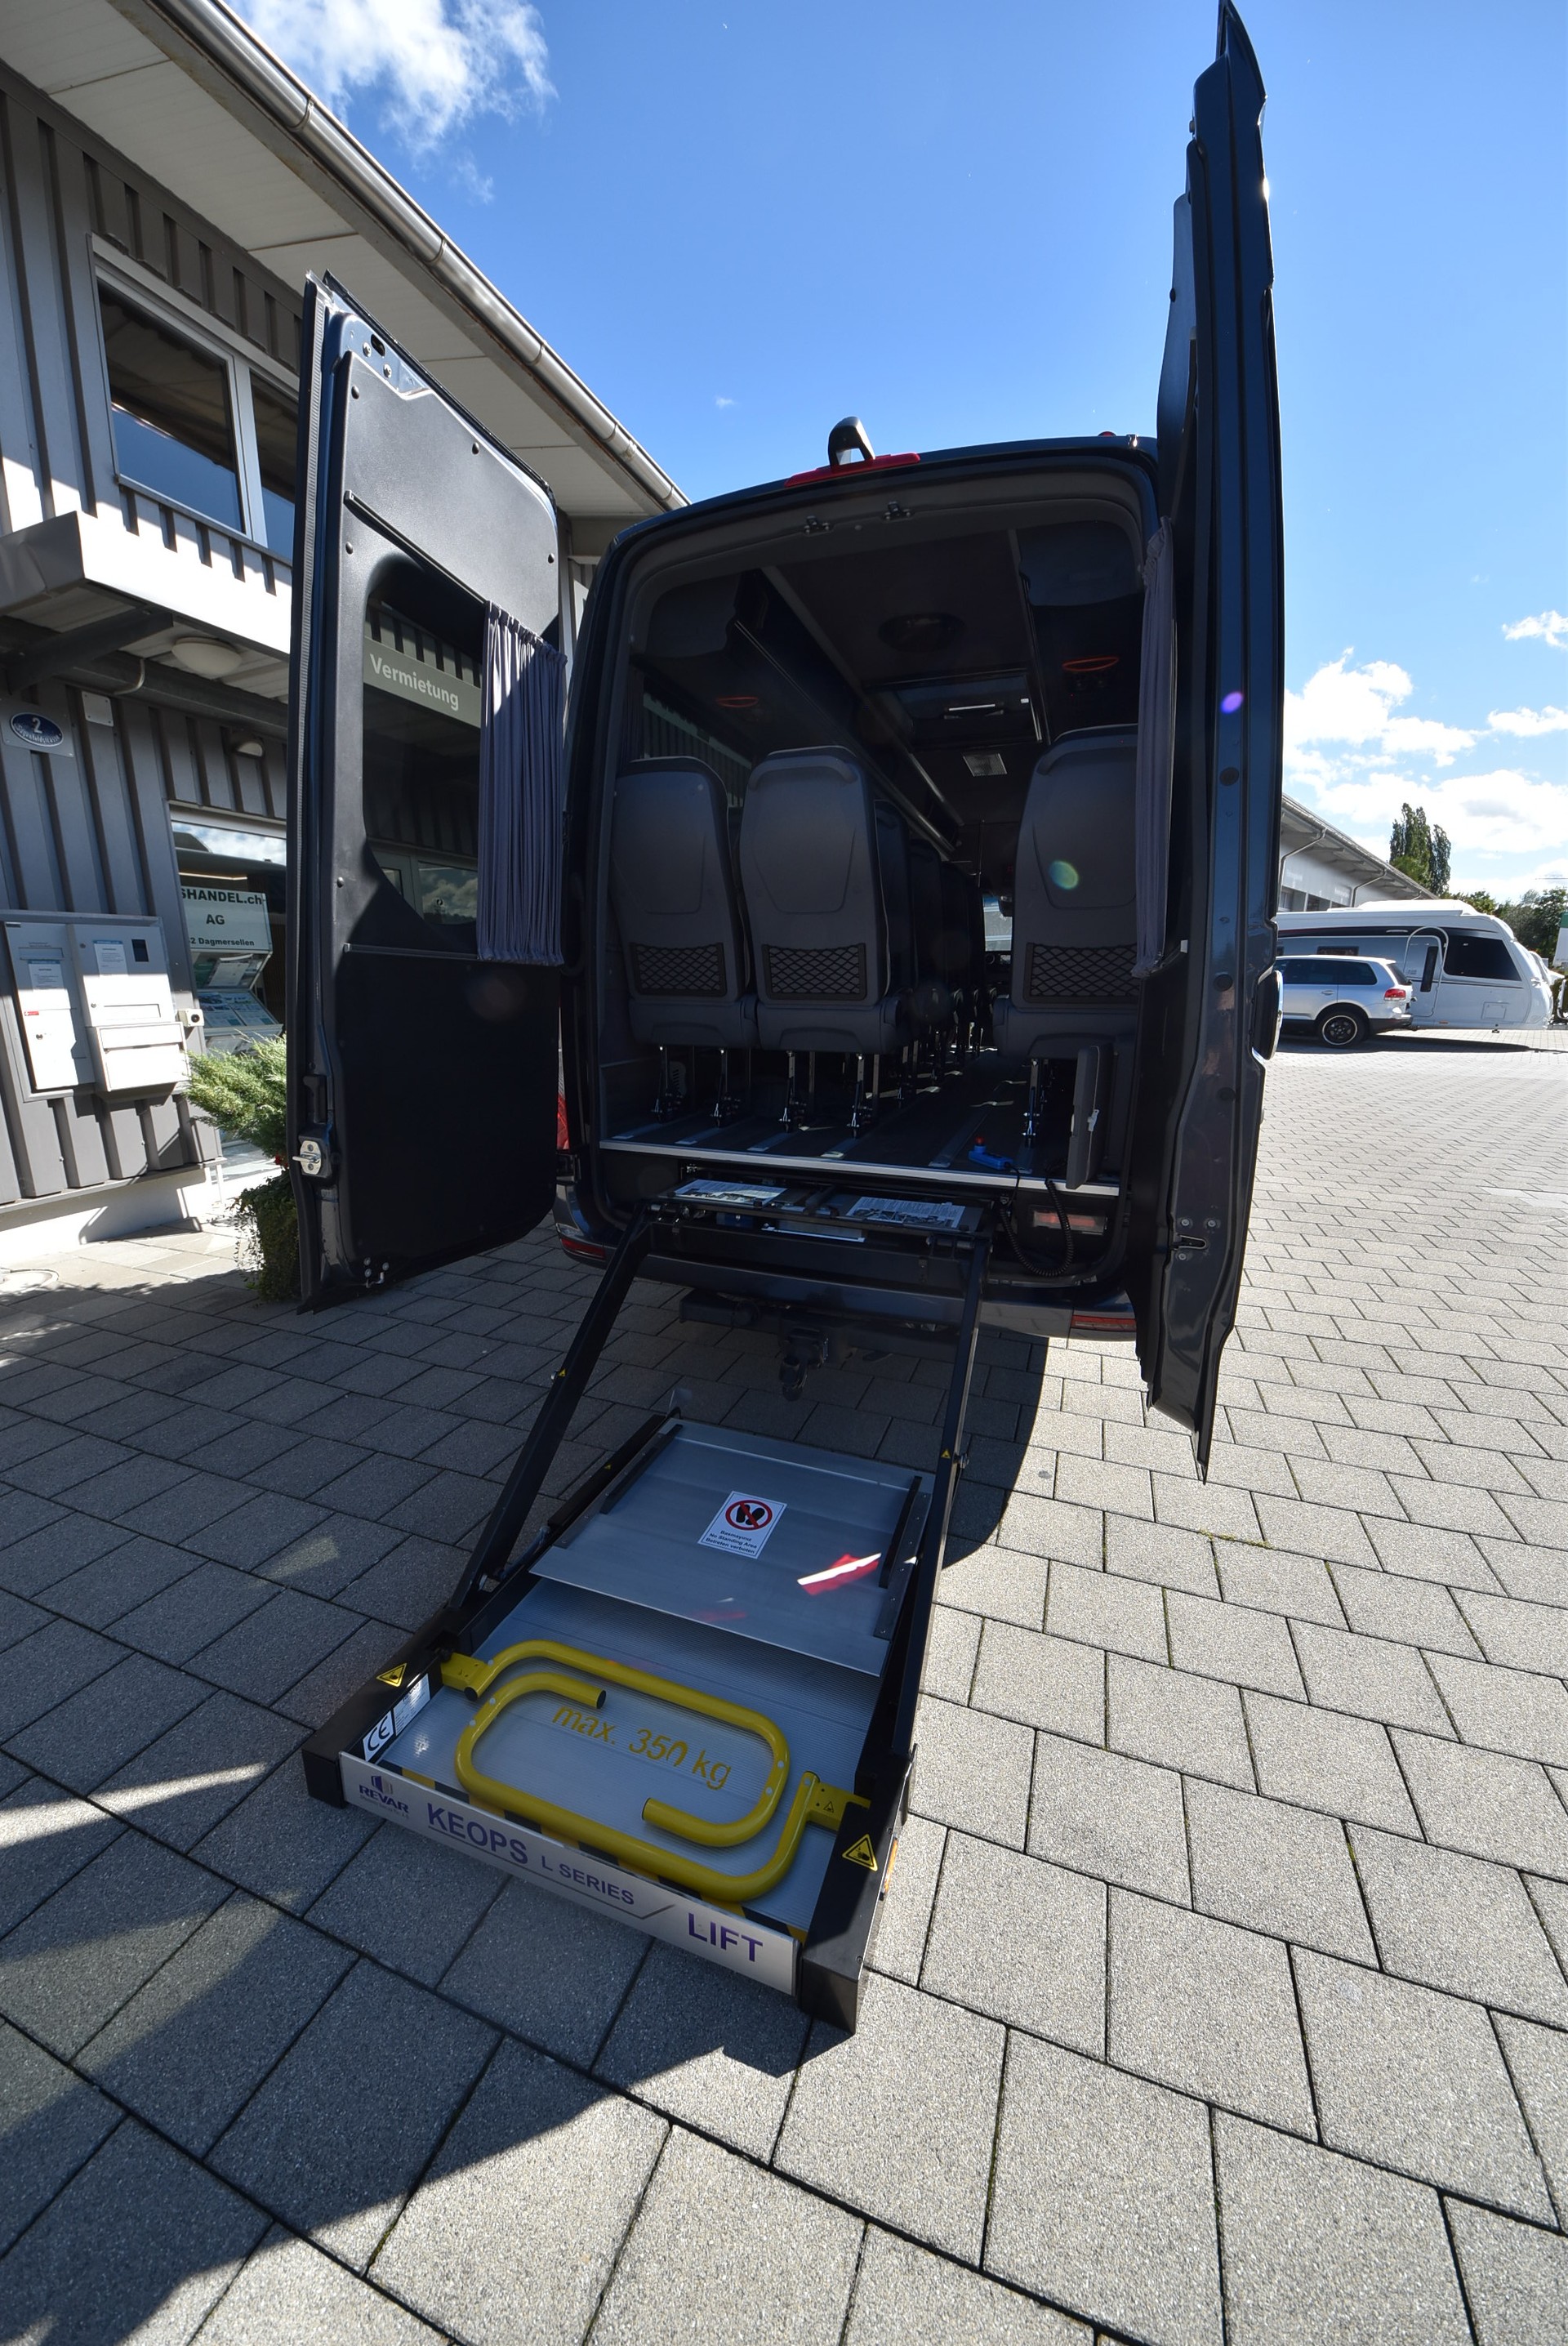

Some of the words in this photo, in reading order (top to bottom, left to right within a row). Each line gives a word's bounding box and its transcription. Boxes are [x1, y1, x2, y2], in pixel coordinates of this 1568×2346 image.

[370, 653, 459, 711] Vermietung
[33, 717, 42, 734] 2
[206, 914, 225, 925] AG
[198, 937, 255, 946] Dagmersellen
[706, 1538, 729, 1547] Betreten
[731, 1545, 755, 1554] verboten
[719, 1536, 743, 1545] Standing
[368, 1715, 390, 1751] CE
[552, 1705, 616, 1746] max.
[692, 1748, 732, 1791] kg
[359, 1784, 409, 1813] REVAR
[427, 1802, 528, 1865] KEOPS
[541, 1855, 553, 1872] L
[559, 1863, 635, 1905] SERIES
[688, 1912, 764, 1963] LIFT
